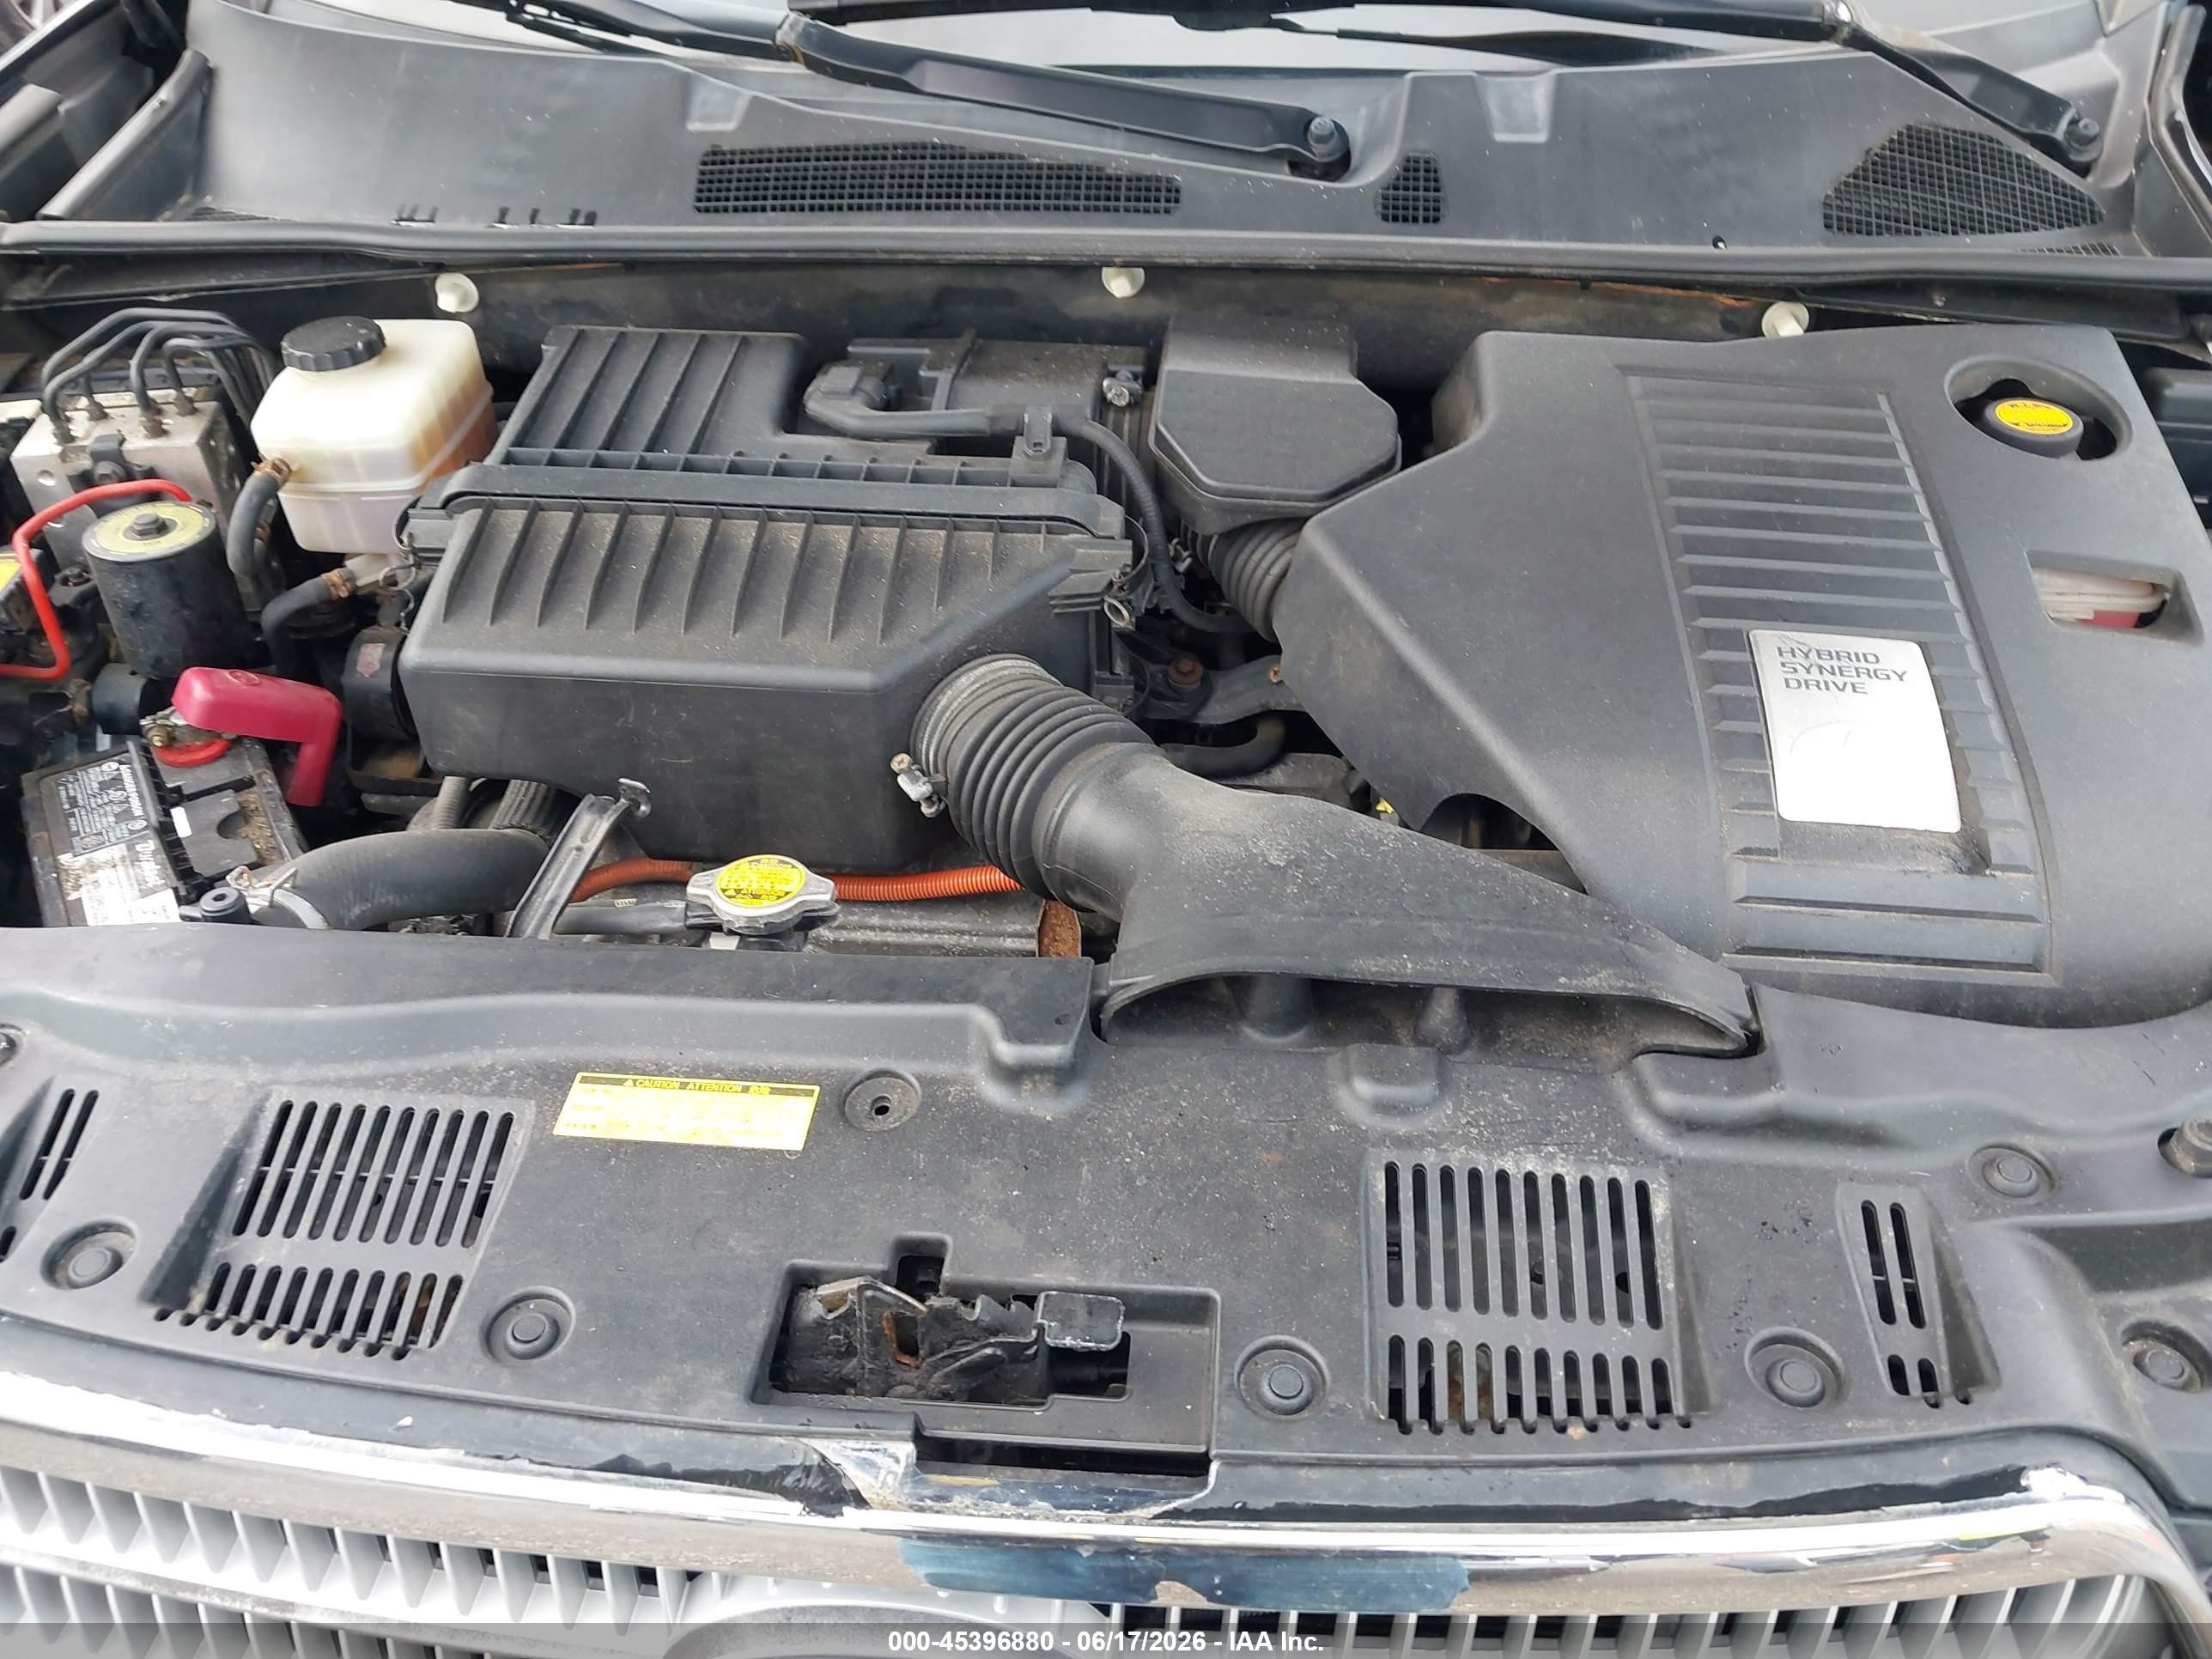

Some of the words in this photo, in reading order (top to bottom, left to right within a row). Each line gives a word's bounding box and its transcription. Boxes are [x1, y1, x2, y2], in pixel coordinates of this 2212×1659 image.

[1777, 647, 1881, 665] HYBRID
[1779, 661, 1907, 682] SYNERGY
[1783, 677, 1869, 695] DRIVE
[635, 1079, 680, 1090] CAUTION
[686, 1082, 743, 1093] ATTENTION
